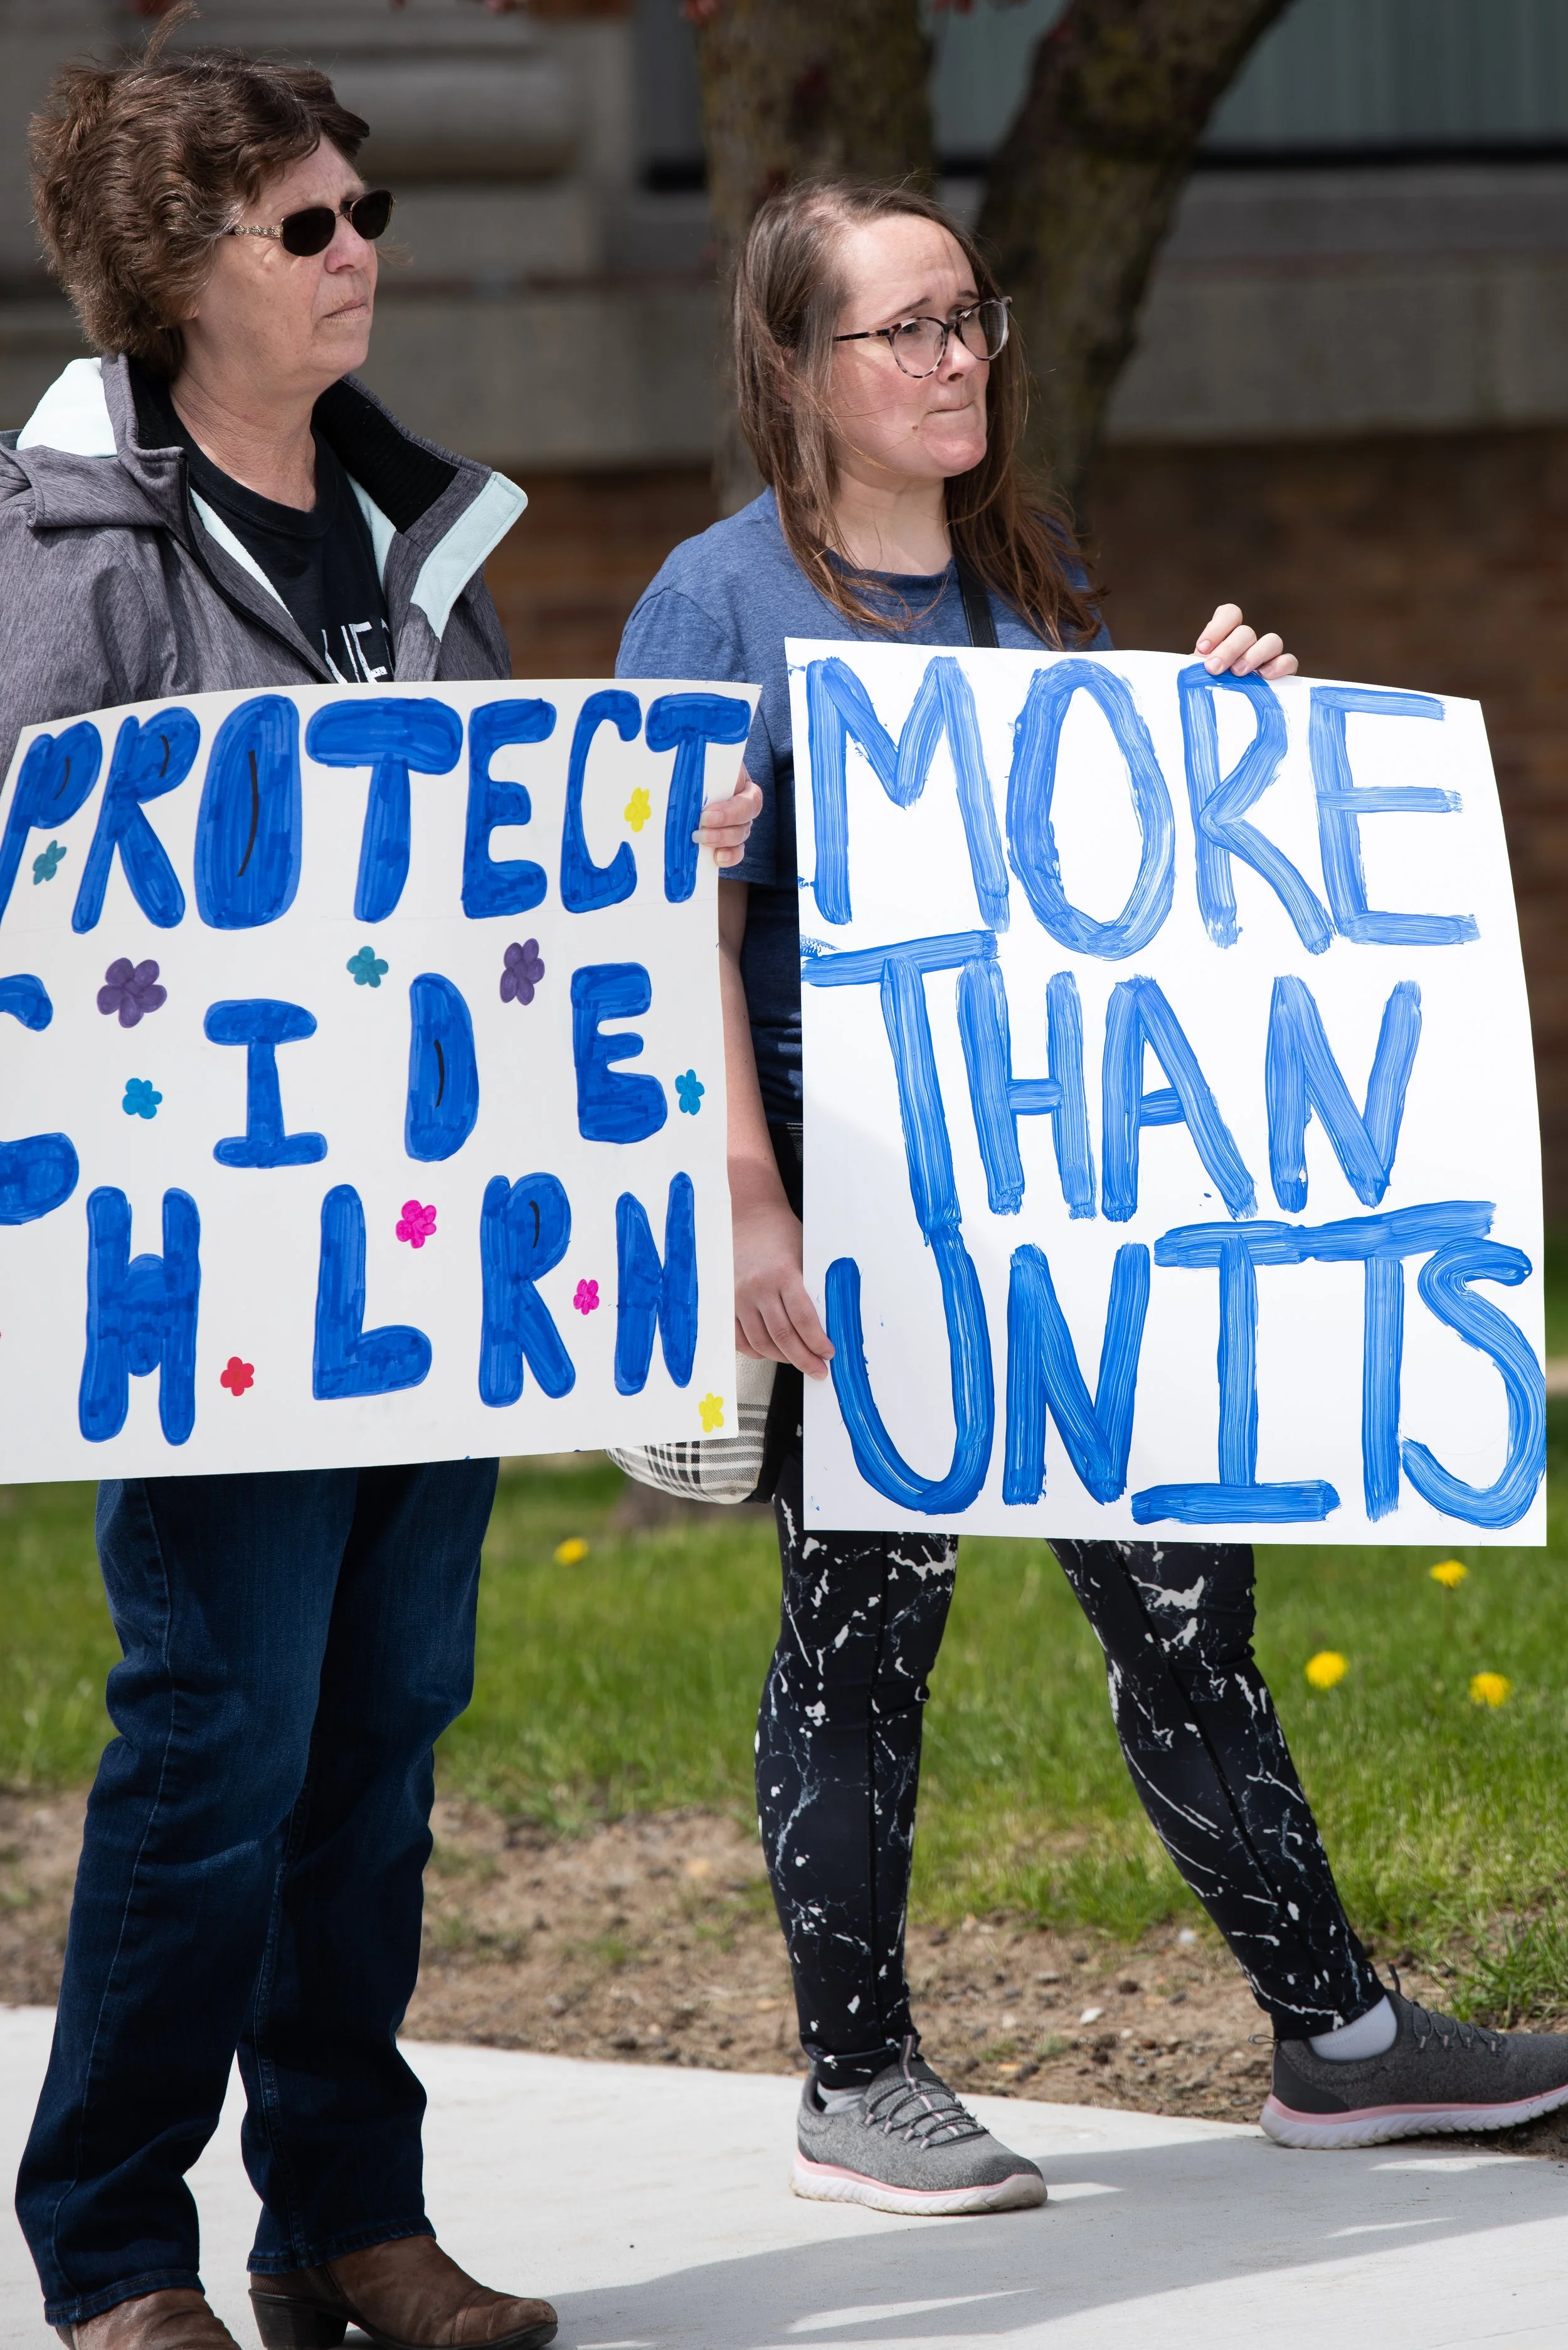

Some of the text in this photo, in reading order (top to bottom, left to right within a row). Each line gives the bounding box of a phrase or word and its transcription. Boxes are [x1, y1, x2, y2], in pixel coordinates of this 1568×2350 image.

[0, 689, 751, 935] PROTECT
[805, 656, 1479, 961] MORE
[801, 930, 1422, 1239] THAN
[825, 1199, 1547, 1529] UNITS
